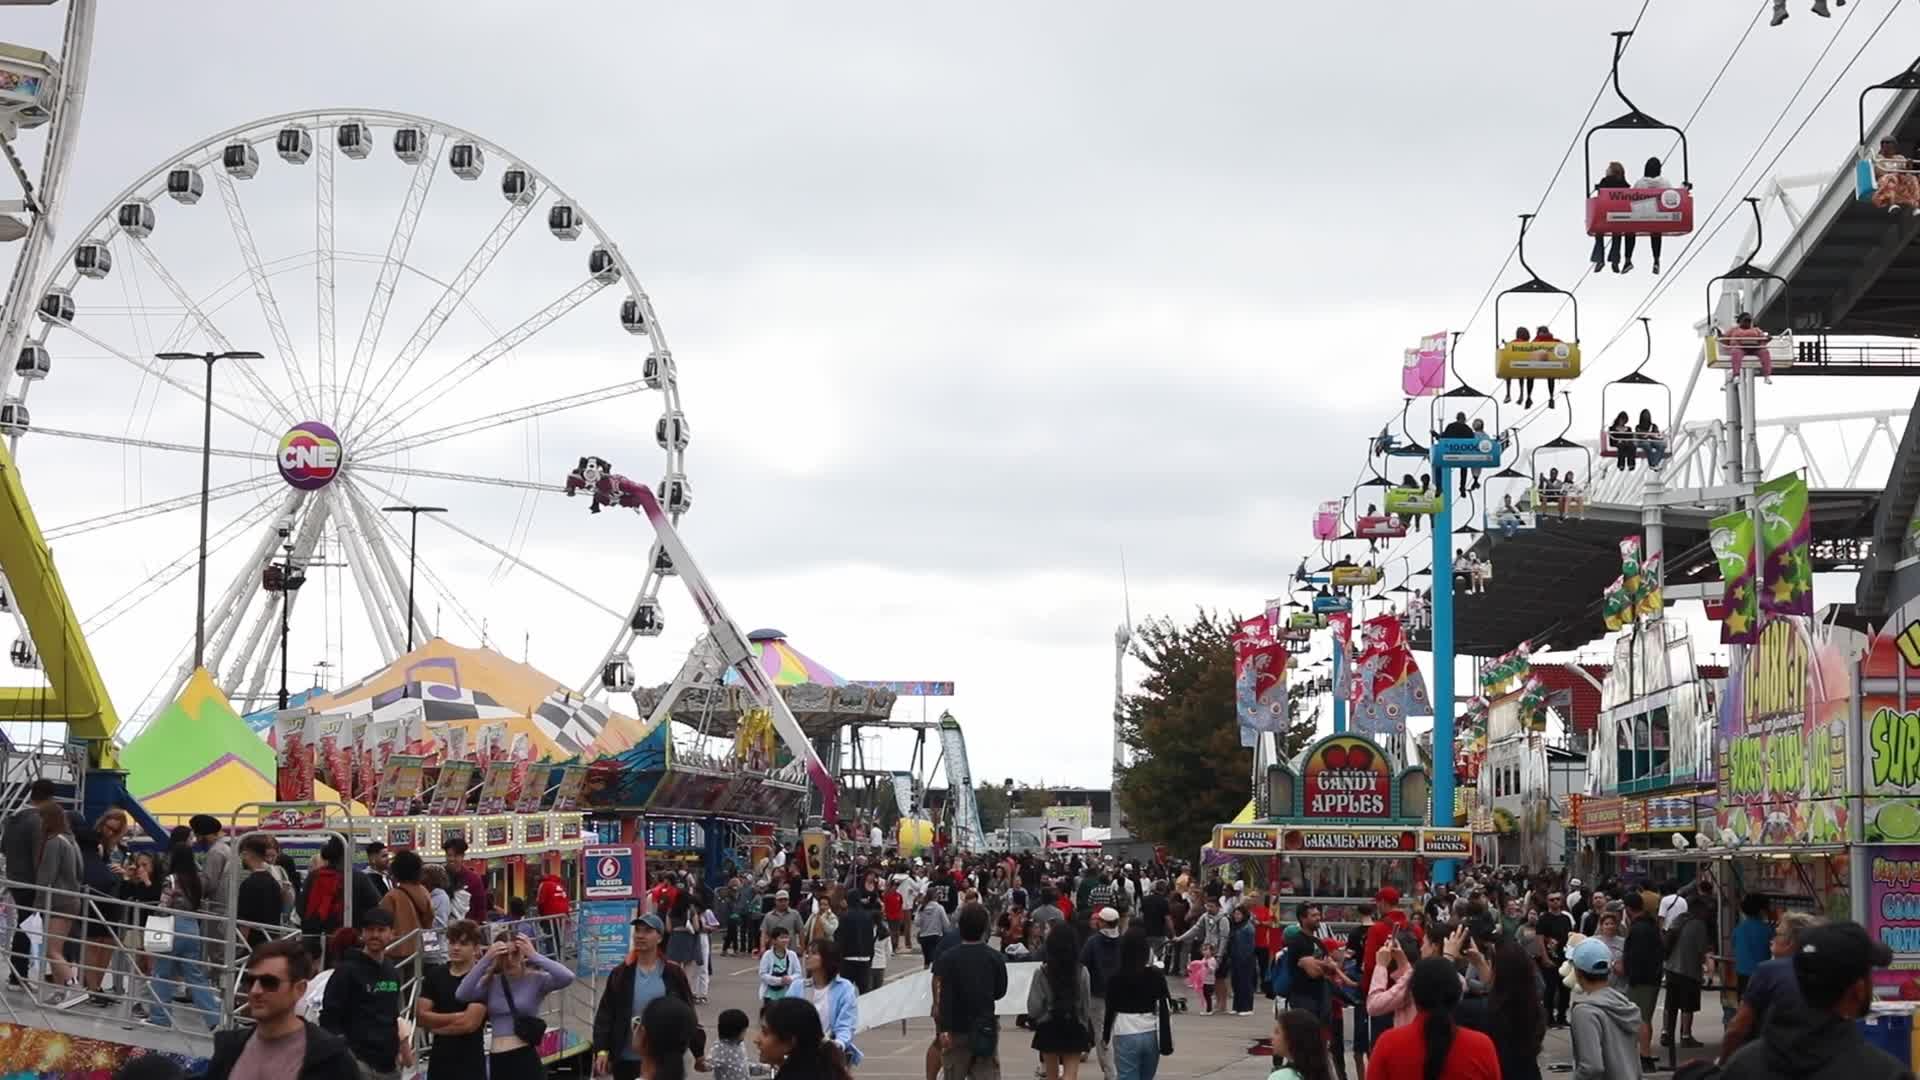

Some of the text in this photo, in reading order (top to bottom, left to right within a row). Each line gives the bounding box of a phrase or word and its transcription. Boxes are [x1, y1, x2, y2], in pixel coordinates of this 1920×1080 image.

[279, 444, 338, 469] CNE
[1870, 707, 1920, 788] SUP
[1729, 734, 1764, 795] SUPER
[1317, 769, 1378, 790] CANDY
[1312, 792, 1384, 813] APPLES
[1227, 839, 1274, 849] DRINKS
[1303, 834, 1399, 849] CARAMEL APPLES
[1426, 842, 1467, 851] DRINKS
[602, 858, 616, 876] 6
